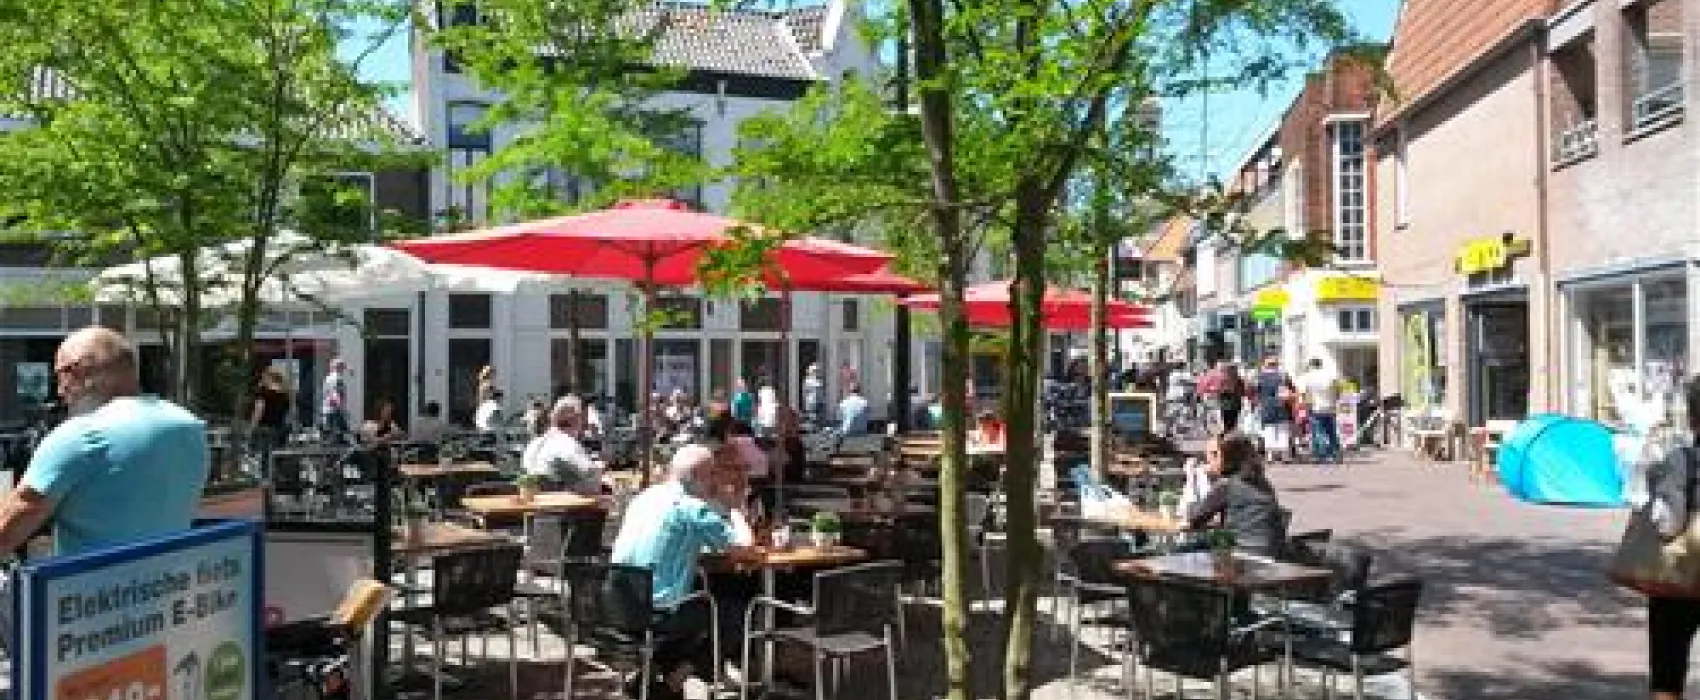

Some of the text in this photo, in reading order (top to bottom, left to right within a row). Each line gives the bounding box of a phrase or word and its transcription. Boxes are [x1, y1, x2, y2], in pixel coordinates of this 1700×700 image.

[57, 590, 237, 662] Premium E-Bike
[58, 572, 190, 625] Elektrische
